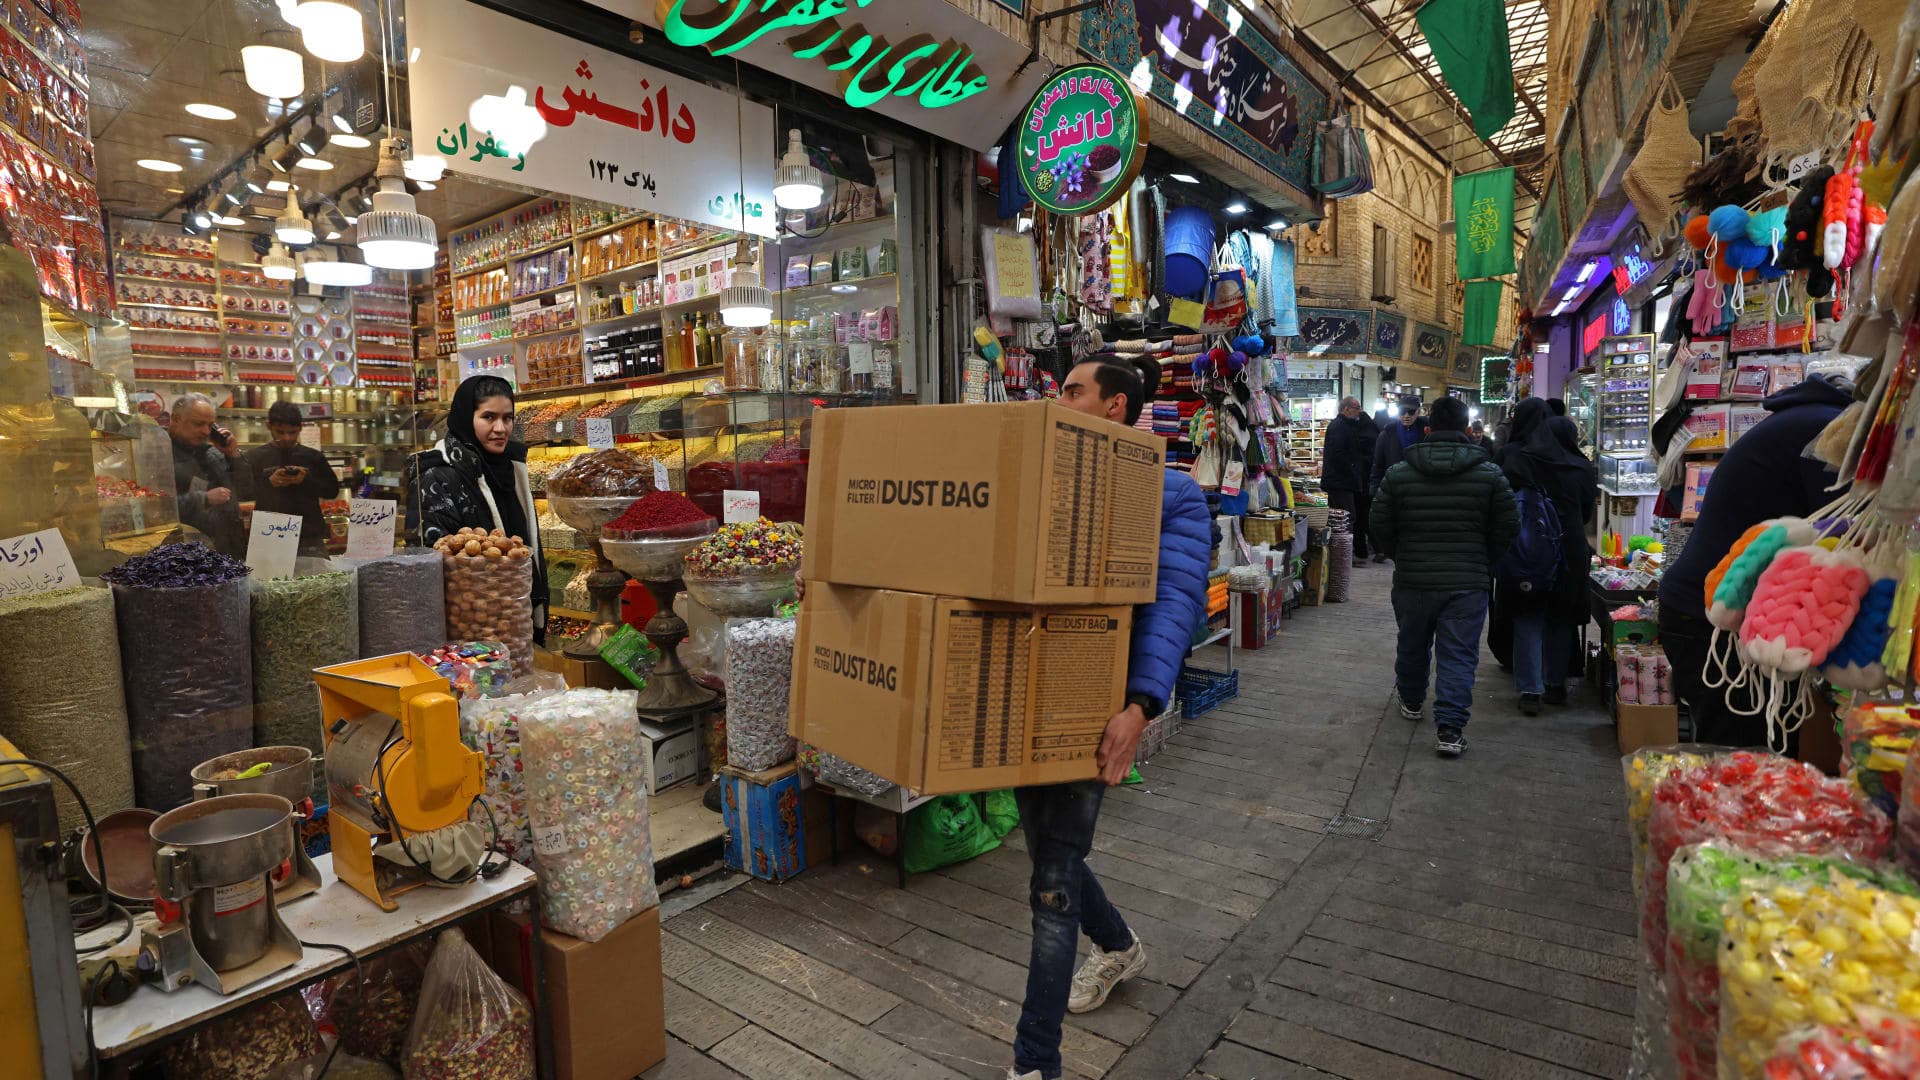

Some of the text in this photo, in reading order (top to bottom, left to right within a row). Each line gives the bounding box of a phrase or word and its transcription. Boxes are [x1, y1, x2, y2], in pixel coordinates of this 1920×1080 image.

[828, 34, 873, 71] و
[845, 43, 989, 108] عطاری
[534, 59, 696, 143] دانش
[1029, 75, 1123, 132] عطاری و زعفران
[1037, 109, 1114, 162] دانش
[588, 158, 656, 198] پلاک ۱۲۳
[707, 191, 763, 220] عطاری
[847, 492, 875, 504] FILTER
[848, 479, 876, 491] MICRO
[882, 479, 989, 508] DUST BAG
[0, 536, 44, 567] اورگا
[1064, 617, 1087, 629] DUST
[1087, 618, 1106, 630] BAG
[814, 658, 830, 671] FILTER
[815, 645, 831, 658] MICRO
[833, 650, 897, 692] DUST BAG
